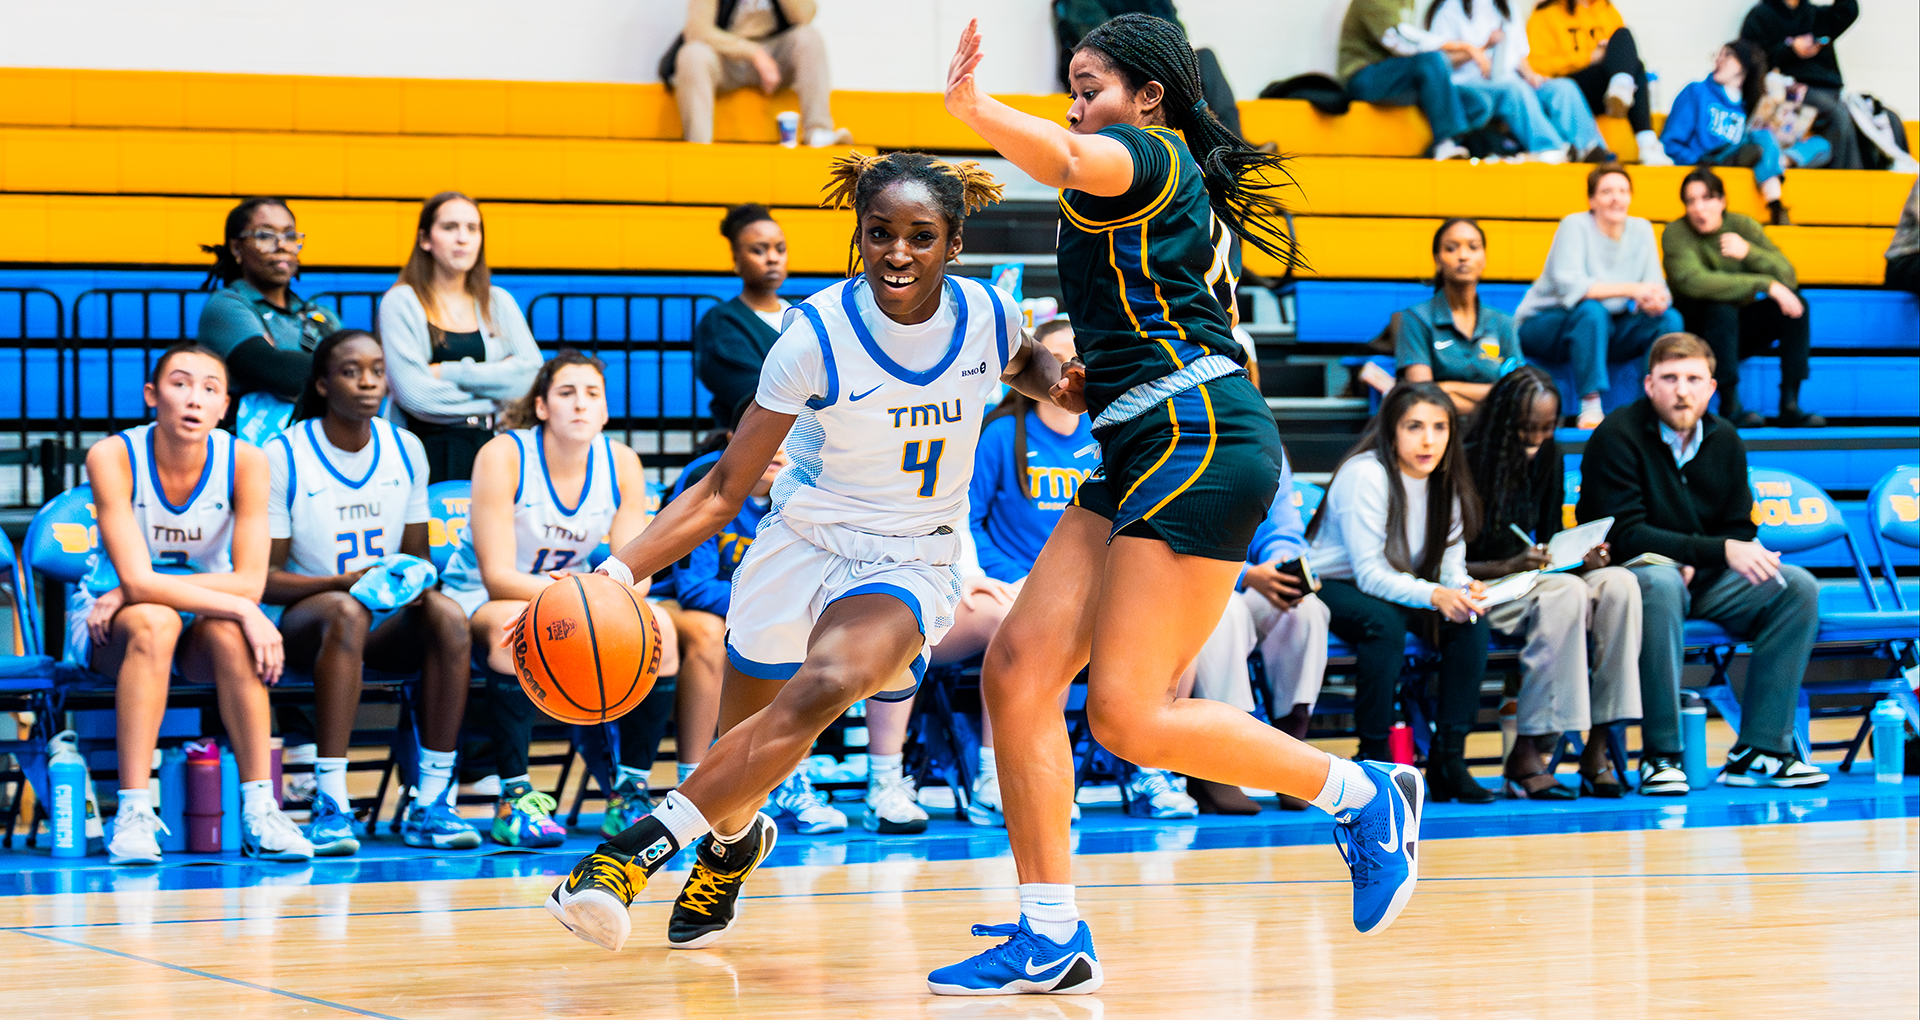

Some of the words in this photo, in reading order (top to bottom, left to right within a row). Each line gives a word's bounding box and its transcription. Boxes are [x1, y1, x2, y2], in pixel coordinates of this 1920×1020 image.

[961, 366, 980, 377] BMO
[887, 398, 962, 428] TMU
[901, 438, 946, 498] 4
[1026, 466, 1092, 499] TM
[335, 502, 381, 520] TMU
[441, 498, 471, 515] TM
[152, 525, 202, 542] TMU
[543, 524, 588, 542] TMU
[335, 526, 385, 575] 25
